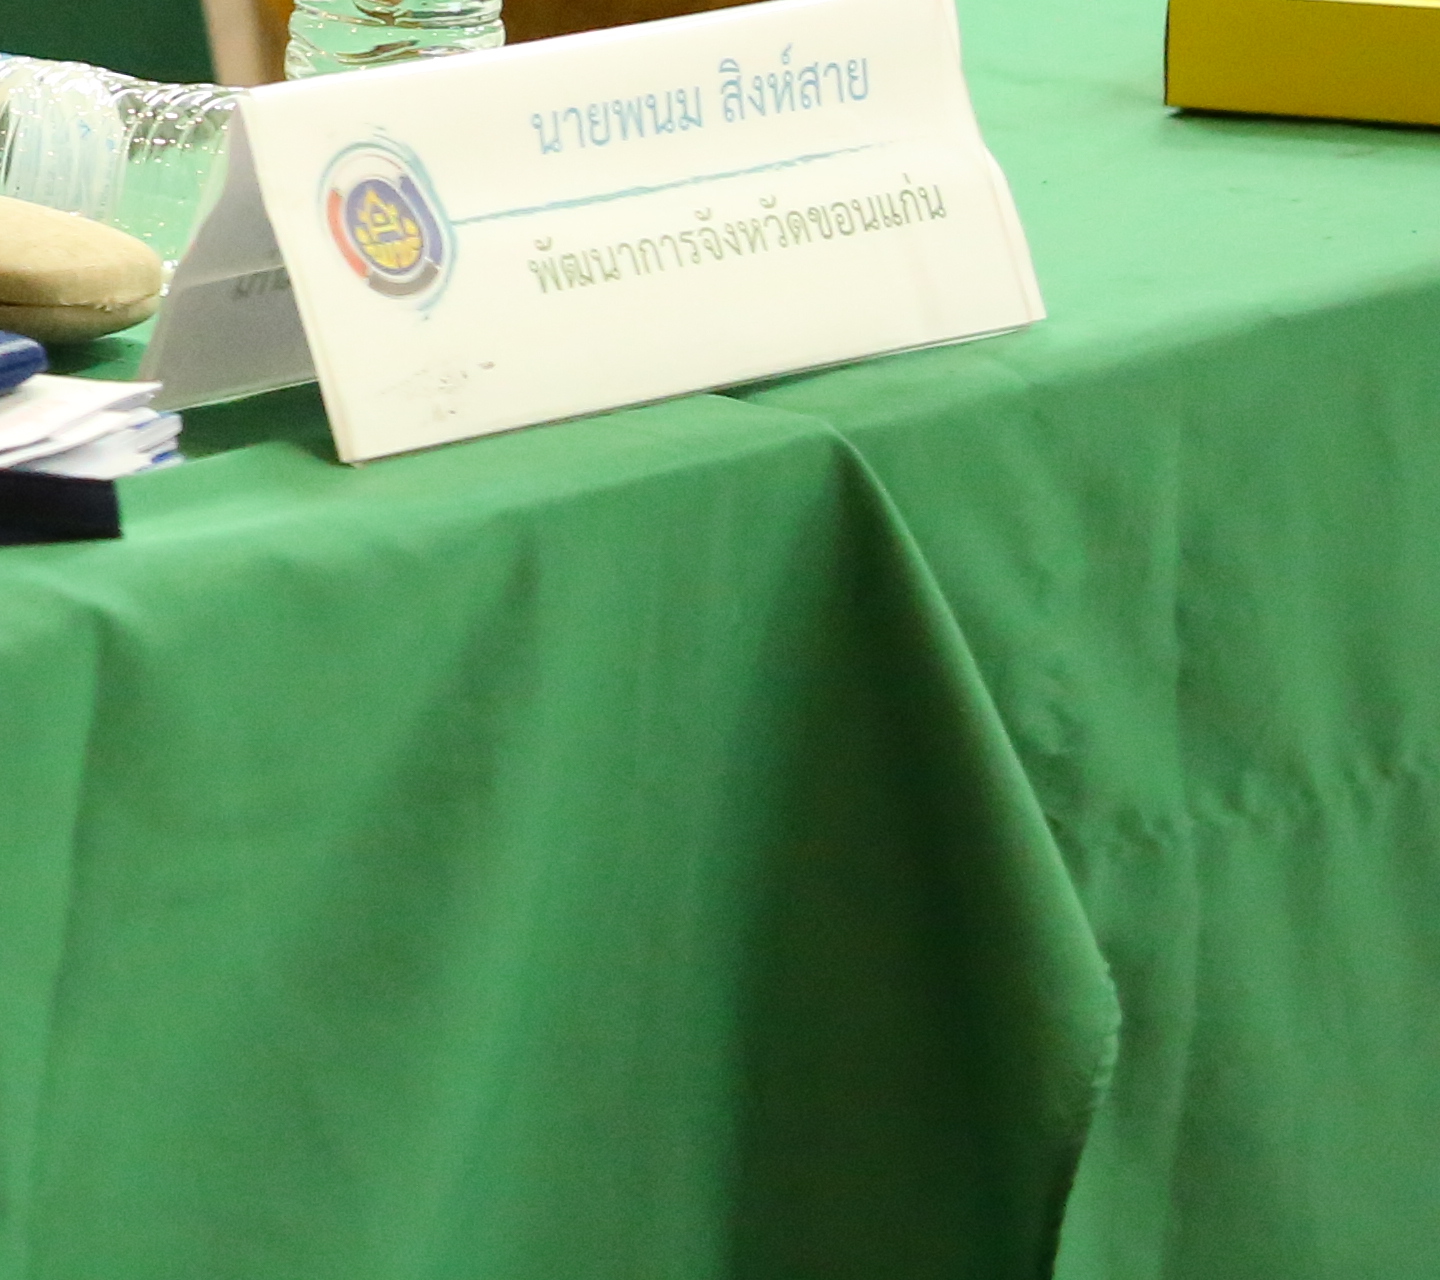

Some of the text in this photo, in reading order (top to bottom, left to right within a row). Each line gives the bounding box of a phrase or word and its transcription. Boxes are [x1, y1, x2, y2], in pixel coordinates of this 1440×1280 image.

[531, 45, 870, 154] นายพนม สิงห์สาย
[530, 174, 947, 294] พัฒนาการจังหวัดขอนแก่น
